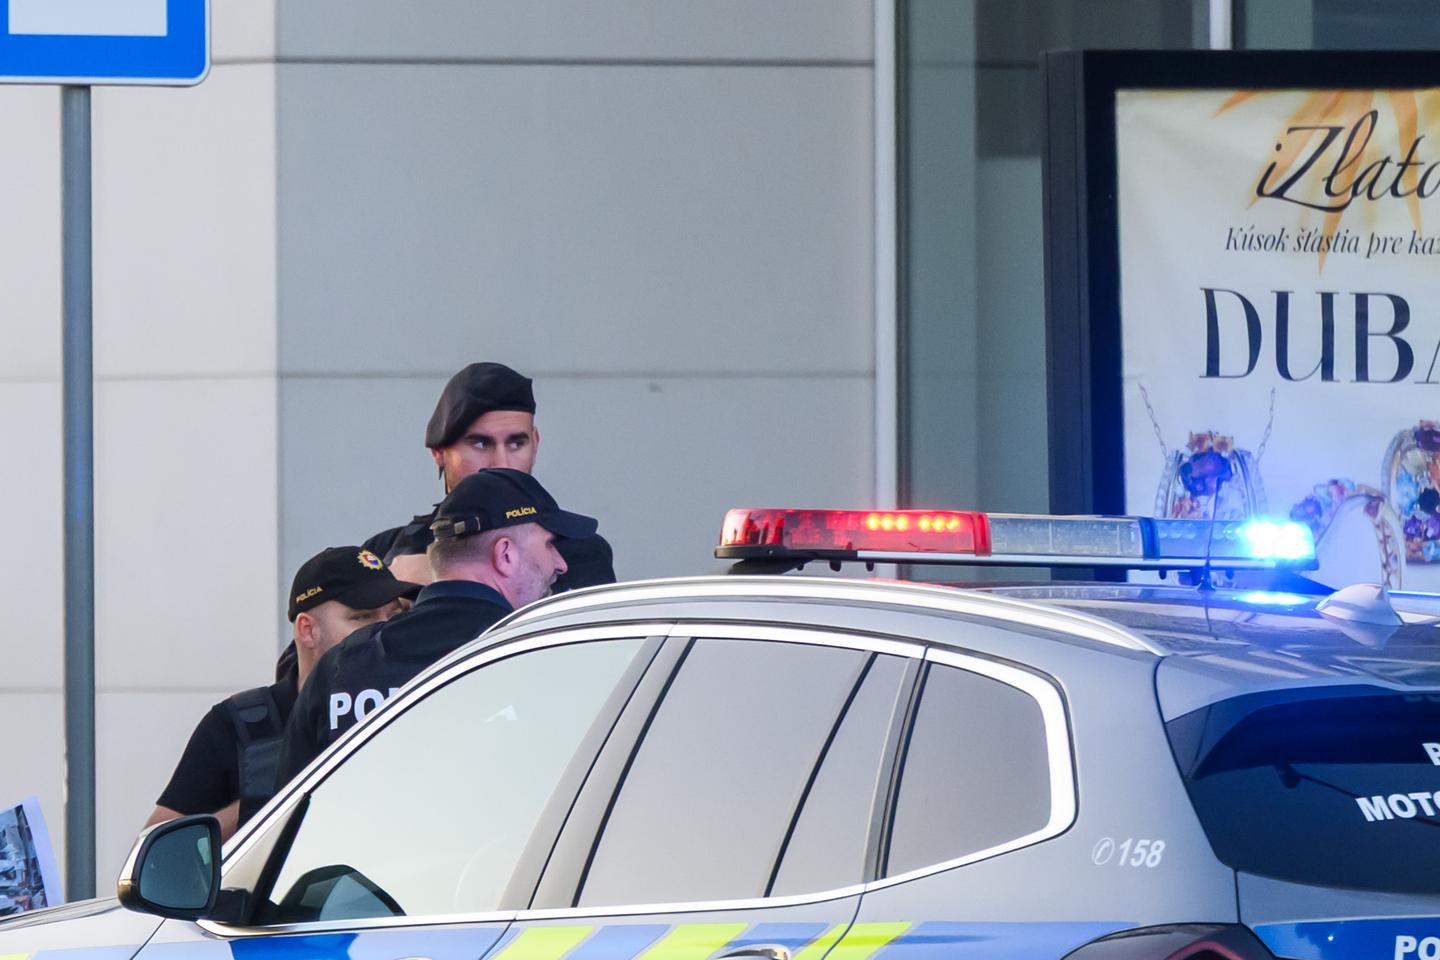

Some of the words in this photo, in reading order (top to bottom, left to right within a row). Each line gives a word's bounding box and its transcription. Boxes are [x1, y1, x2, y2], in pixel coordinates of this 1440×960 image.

[1225, 224, 1289, 251] Kúsok
[1292, 227, 1360, 254] šťastia
[1366, 232, 1403, 259] pre
[1198, 286, 1440, 385] DUB
[1117, 838, 1166, 868] 158
